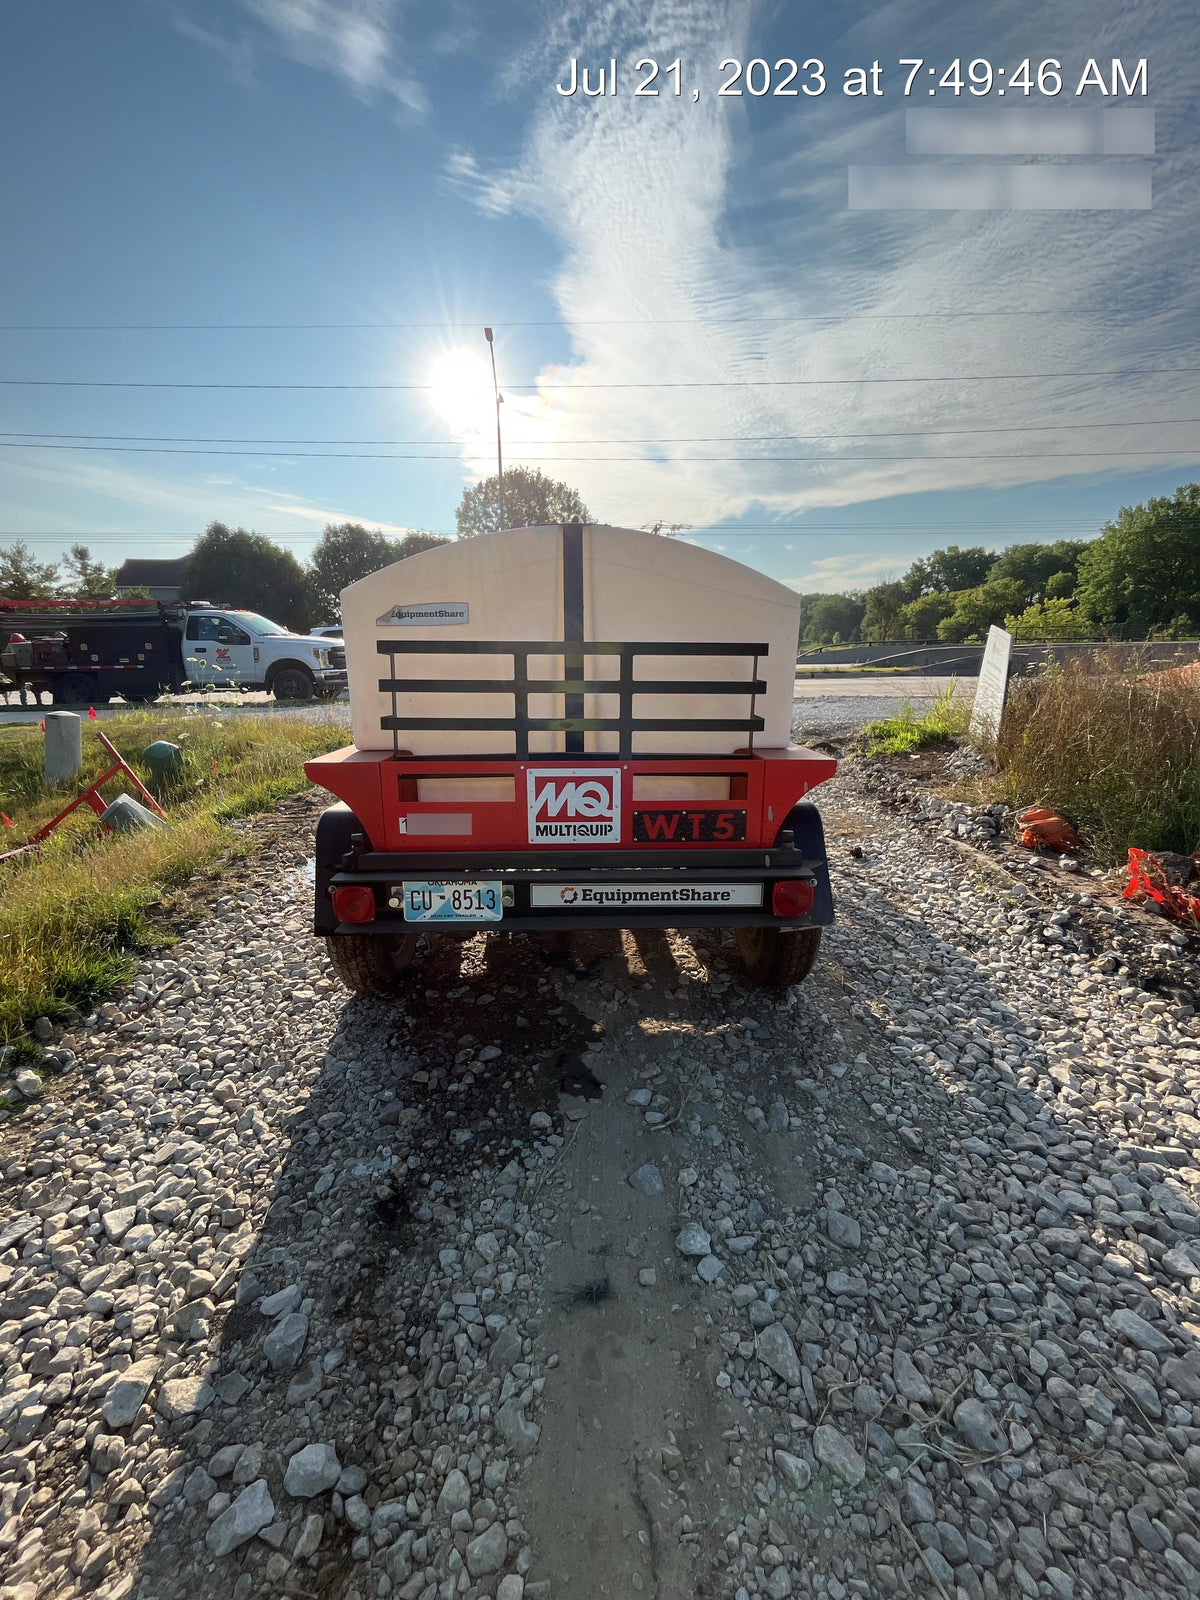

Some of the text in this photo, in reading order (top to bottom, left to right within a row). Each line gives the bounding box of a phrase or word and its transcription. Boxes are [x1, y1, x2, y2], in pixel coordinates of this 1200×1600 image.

[535, 781, 614, 817] MQ
[535, 824, 613, 837] MULTIQUIP
[410, 889, 496, 911] CU 8513
[581, 888, 731, 904] EquipmentShare
